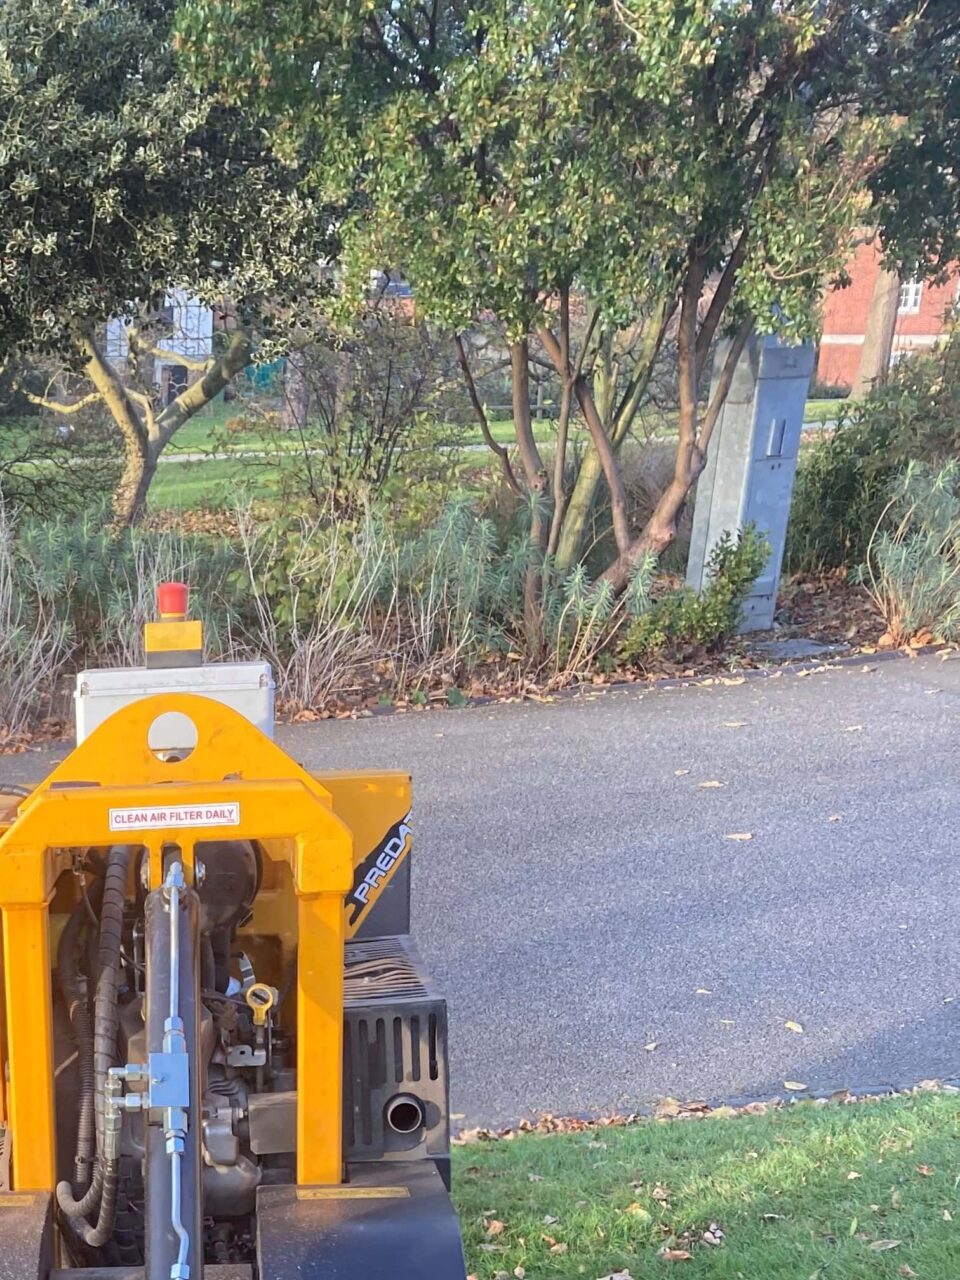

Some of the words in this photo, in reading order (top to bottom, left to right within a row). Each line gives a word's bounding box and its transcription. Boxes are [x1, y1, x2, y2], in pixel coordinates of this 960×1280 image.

[114, 812, 148, 824] CLEAN
[149, 812, 167, 822] AIR
[169, 810, 203, 821] FILTER
[205, 808, 234, 820] DAILY
